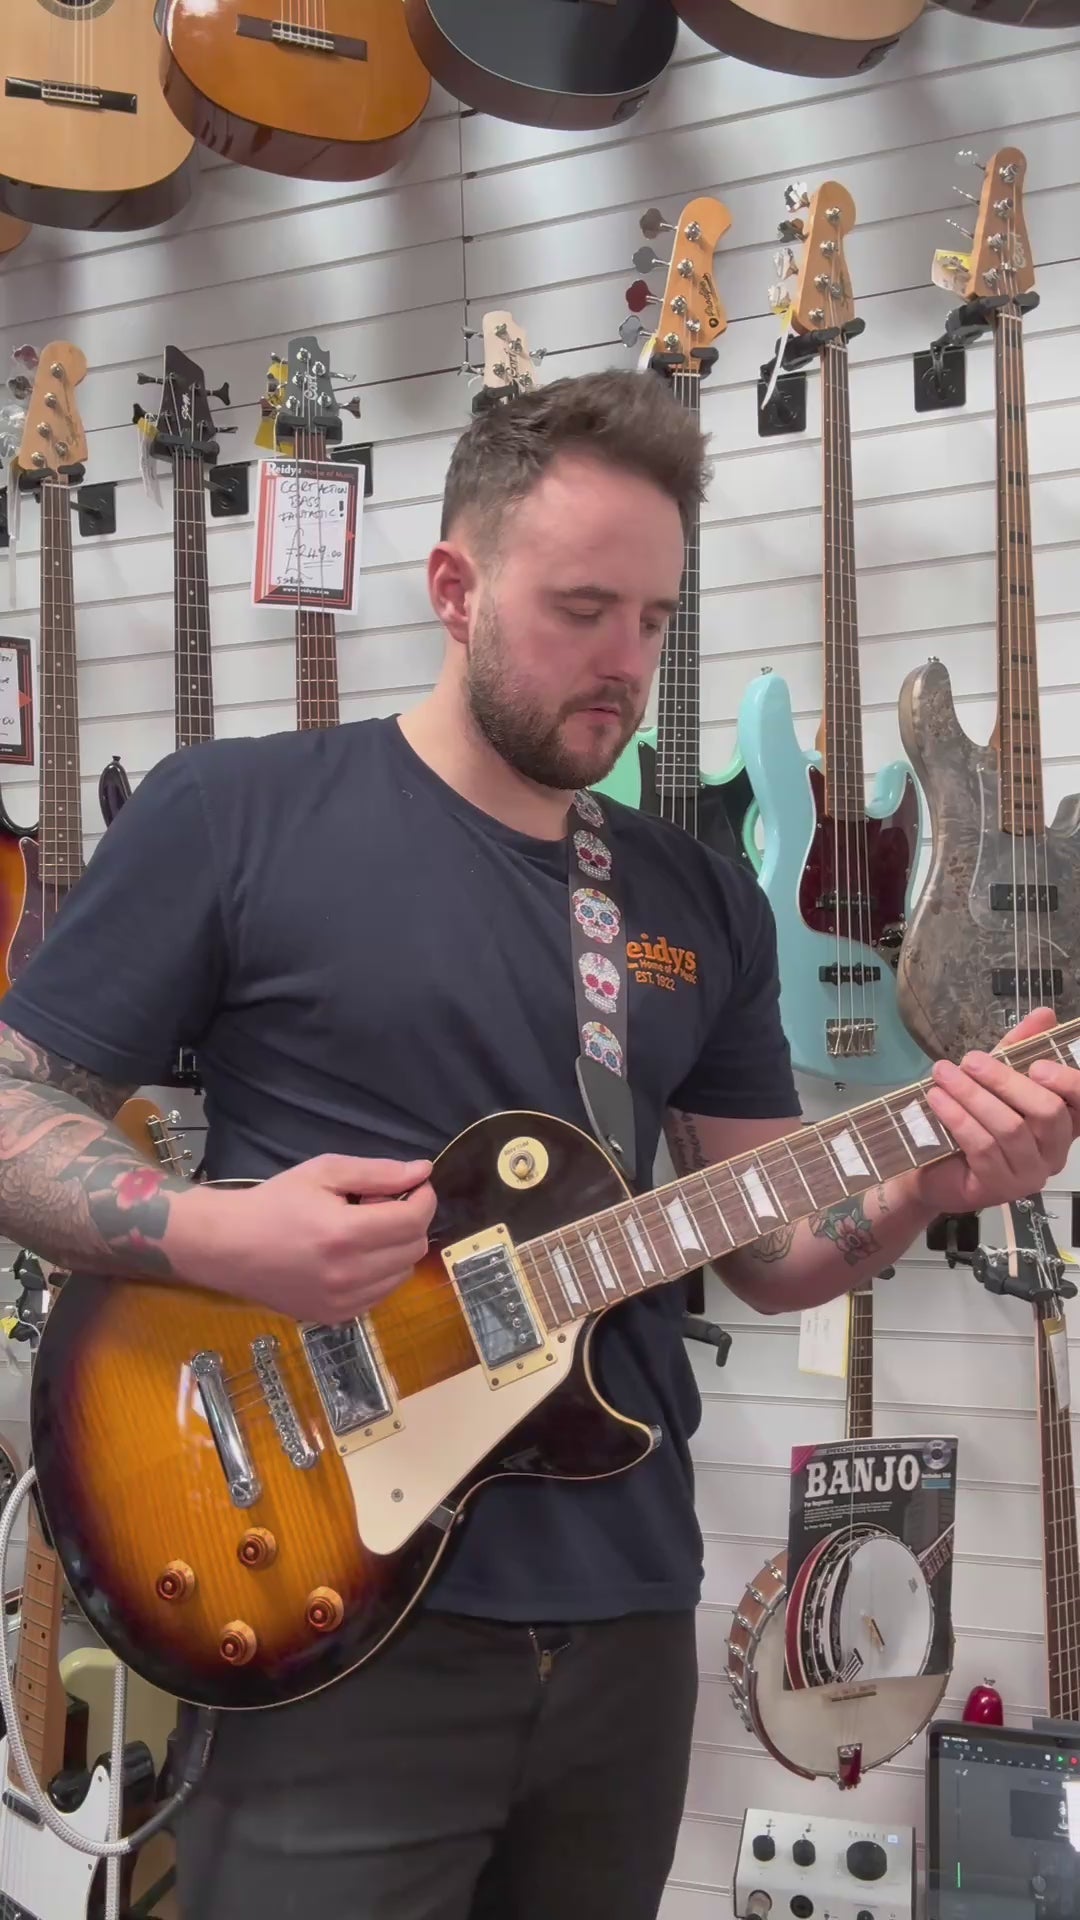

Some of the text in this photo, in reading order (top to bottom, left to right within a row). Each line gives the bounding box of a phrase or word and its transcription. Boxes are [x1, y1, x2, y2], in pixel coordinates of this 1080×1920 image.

[265, 461, 302, 476] Reidys
[626, 933, 697, 974] eidys
[804, 1454, 920, 1499] BANJO
